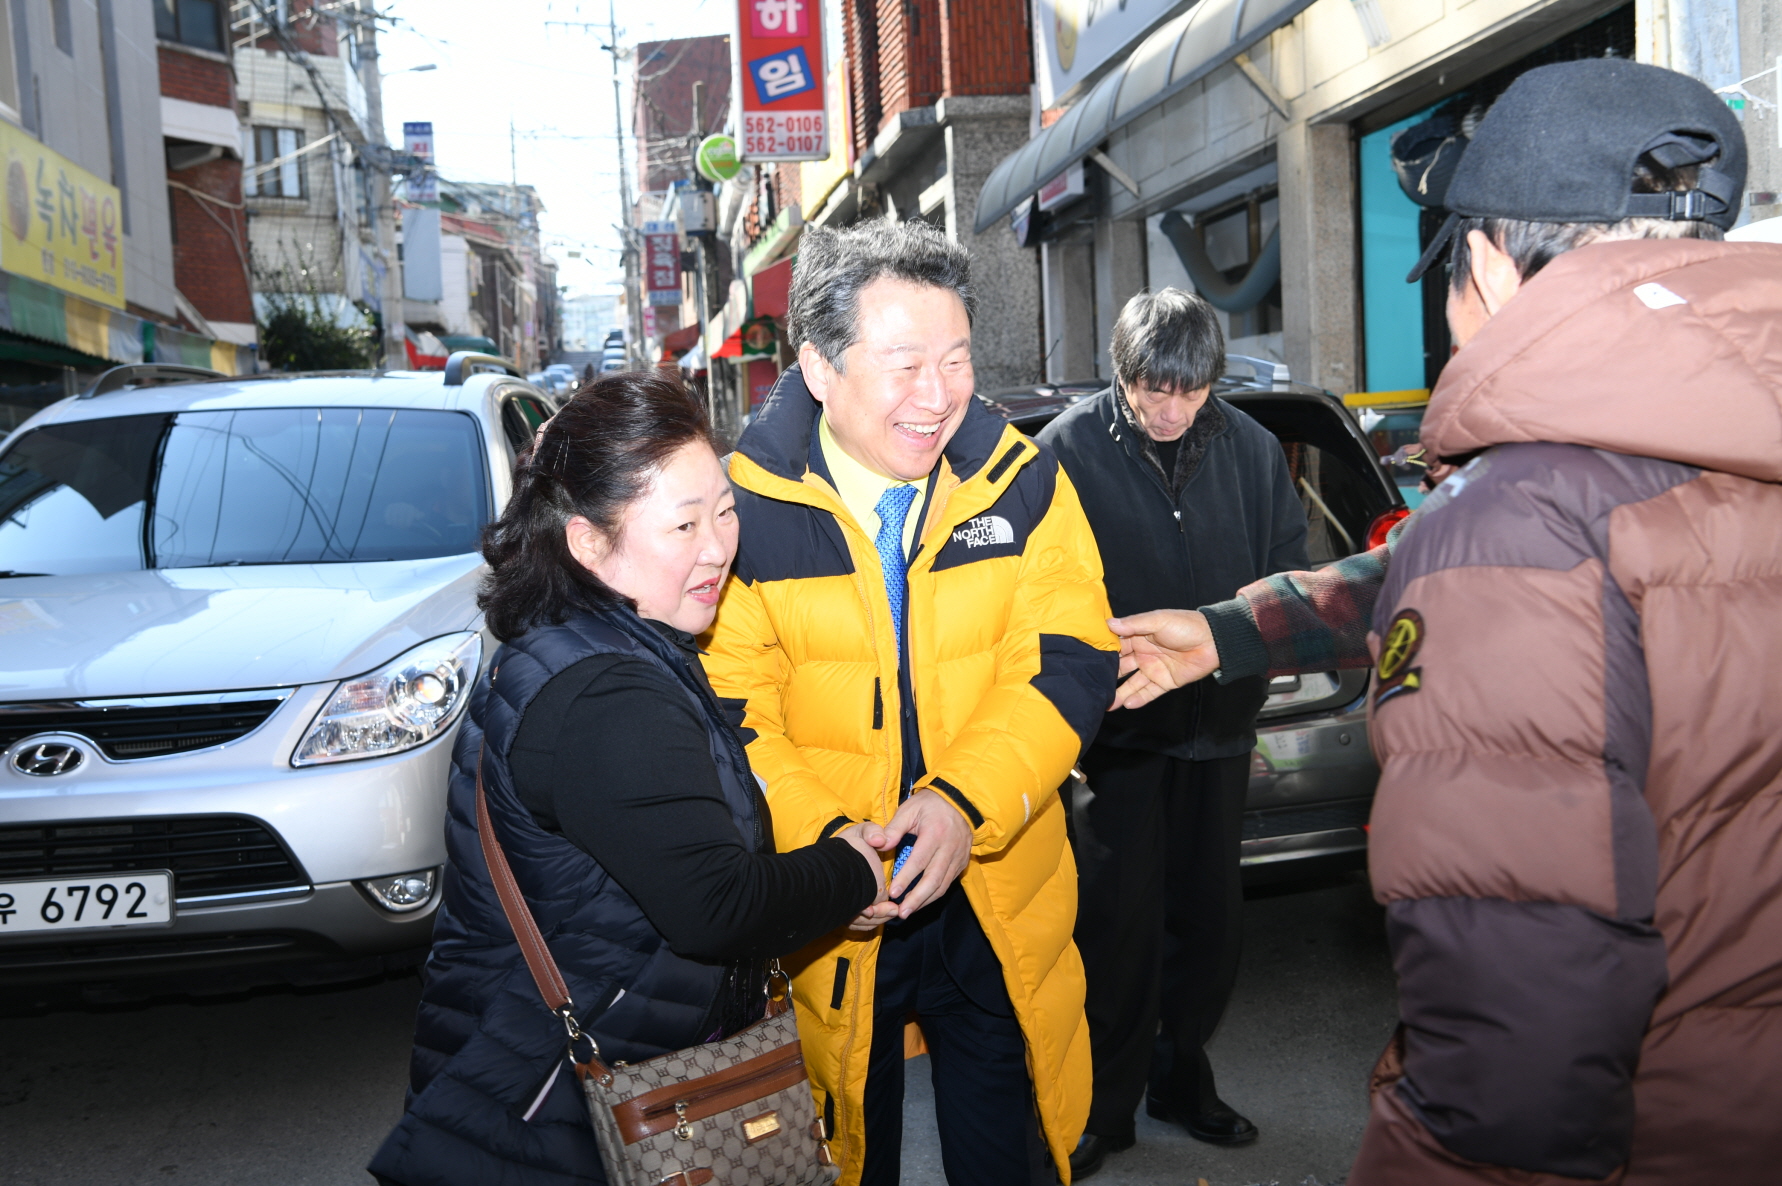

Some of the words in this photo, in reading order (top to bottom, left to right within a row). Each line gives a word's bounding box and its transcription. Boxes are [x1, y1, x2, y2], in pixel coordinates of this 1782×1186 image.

[746, 116, 823, 133] 562-0106
[746, 136, 823, 152] 562-0107
[968, 516, 992, 528] THE
[952, 526, 994, 542] NORTH
[966, 535, 996, 548] FACE
[41, 882, 148, 923] 6792
